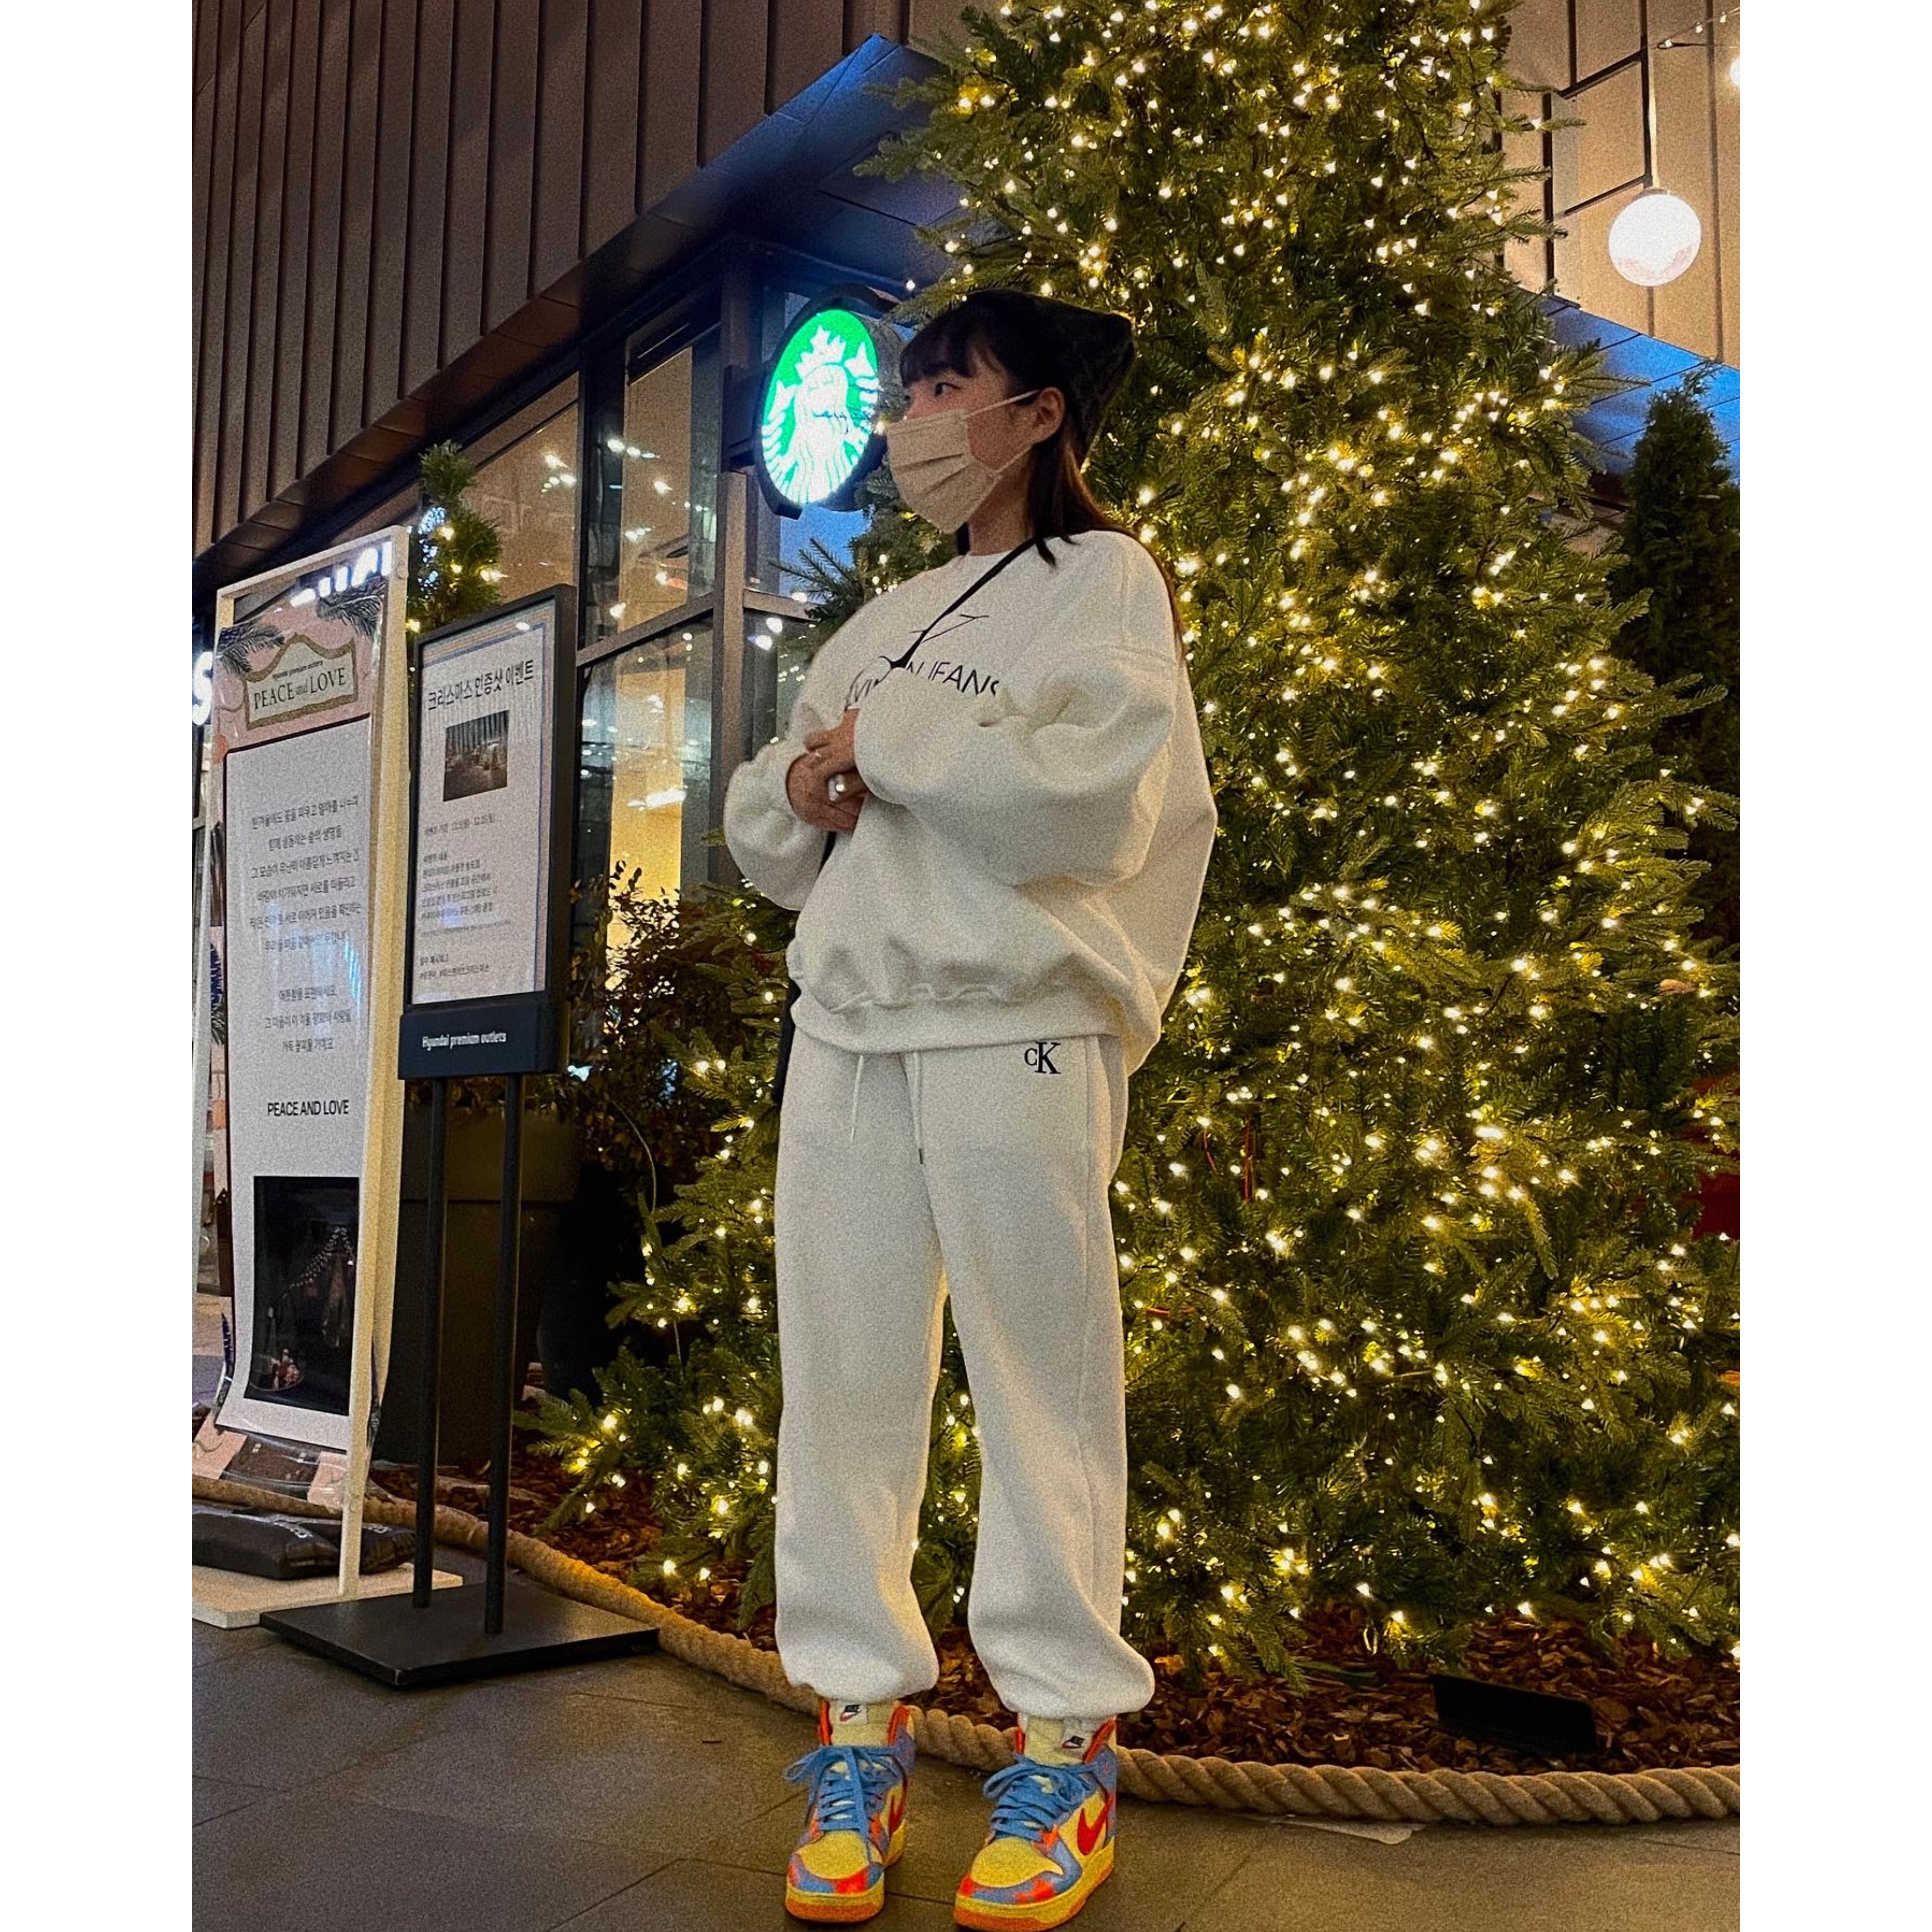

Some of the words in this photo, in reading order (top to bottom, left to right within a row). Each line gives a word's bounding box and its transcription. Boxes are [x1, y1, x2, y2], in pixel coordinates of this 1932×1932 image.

[254, 682, 294, 709] PEACE
[310, 667, 346, 693] LOVE
[428, 681, 472, 711] 크리스마스
[474, 669, 503, 698] 인증샷
[506, 660, 534, 686] 이벤트
[268, 1101, 298, 1117] PEACE
[301, 1101, 322, 1116] AND
[323, 1100, 350, 1115] LOVE
